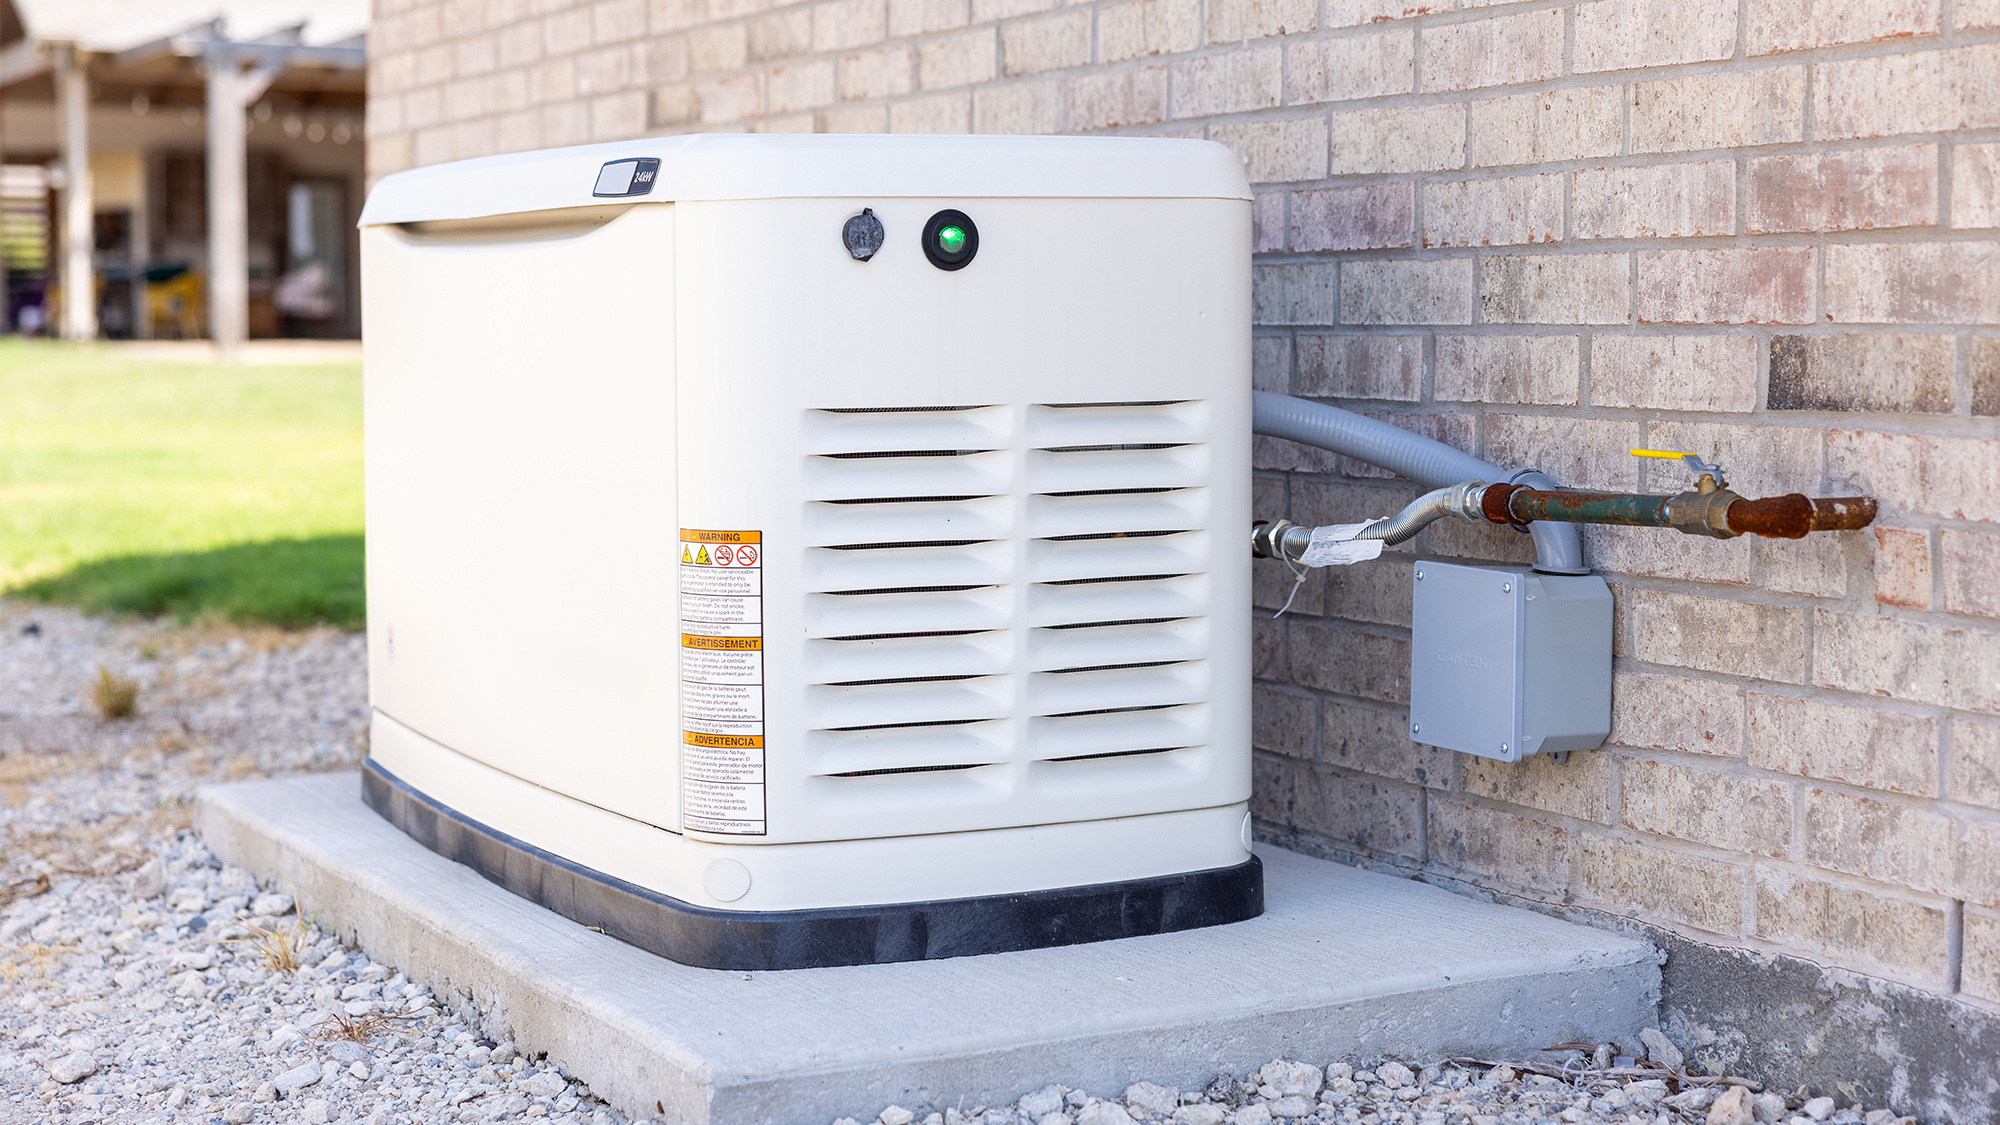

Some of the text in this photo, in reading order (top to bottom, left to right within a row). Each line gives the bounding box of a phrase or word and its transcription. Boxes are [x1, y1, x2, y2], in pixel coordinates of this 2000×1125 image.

[634, 171, 654, 182] 24kW
[699, 533, 740, 541] WARNING
[689, 638, 758, 648] AVERTISSEMENT
[1437, 650, 1488, 670] CANTEX
[695, 736, 754, 746] ADVERTENCIA
